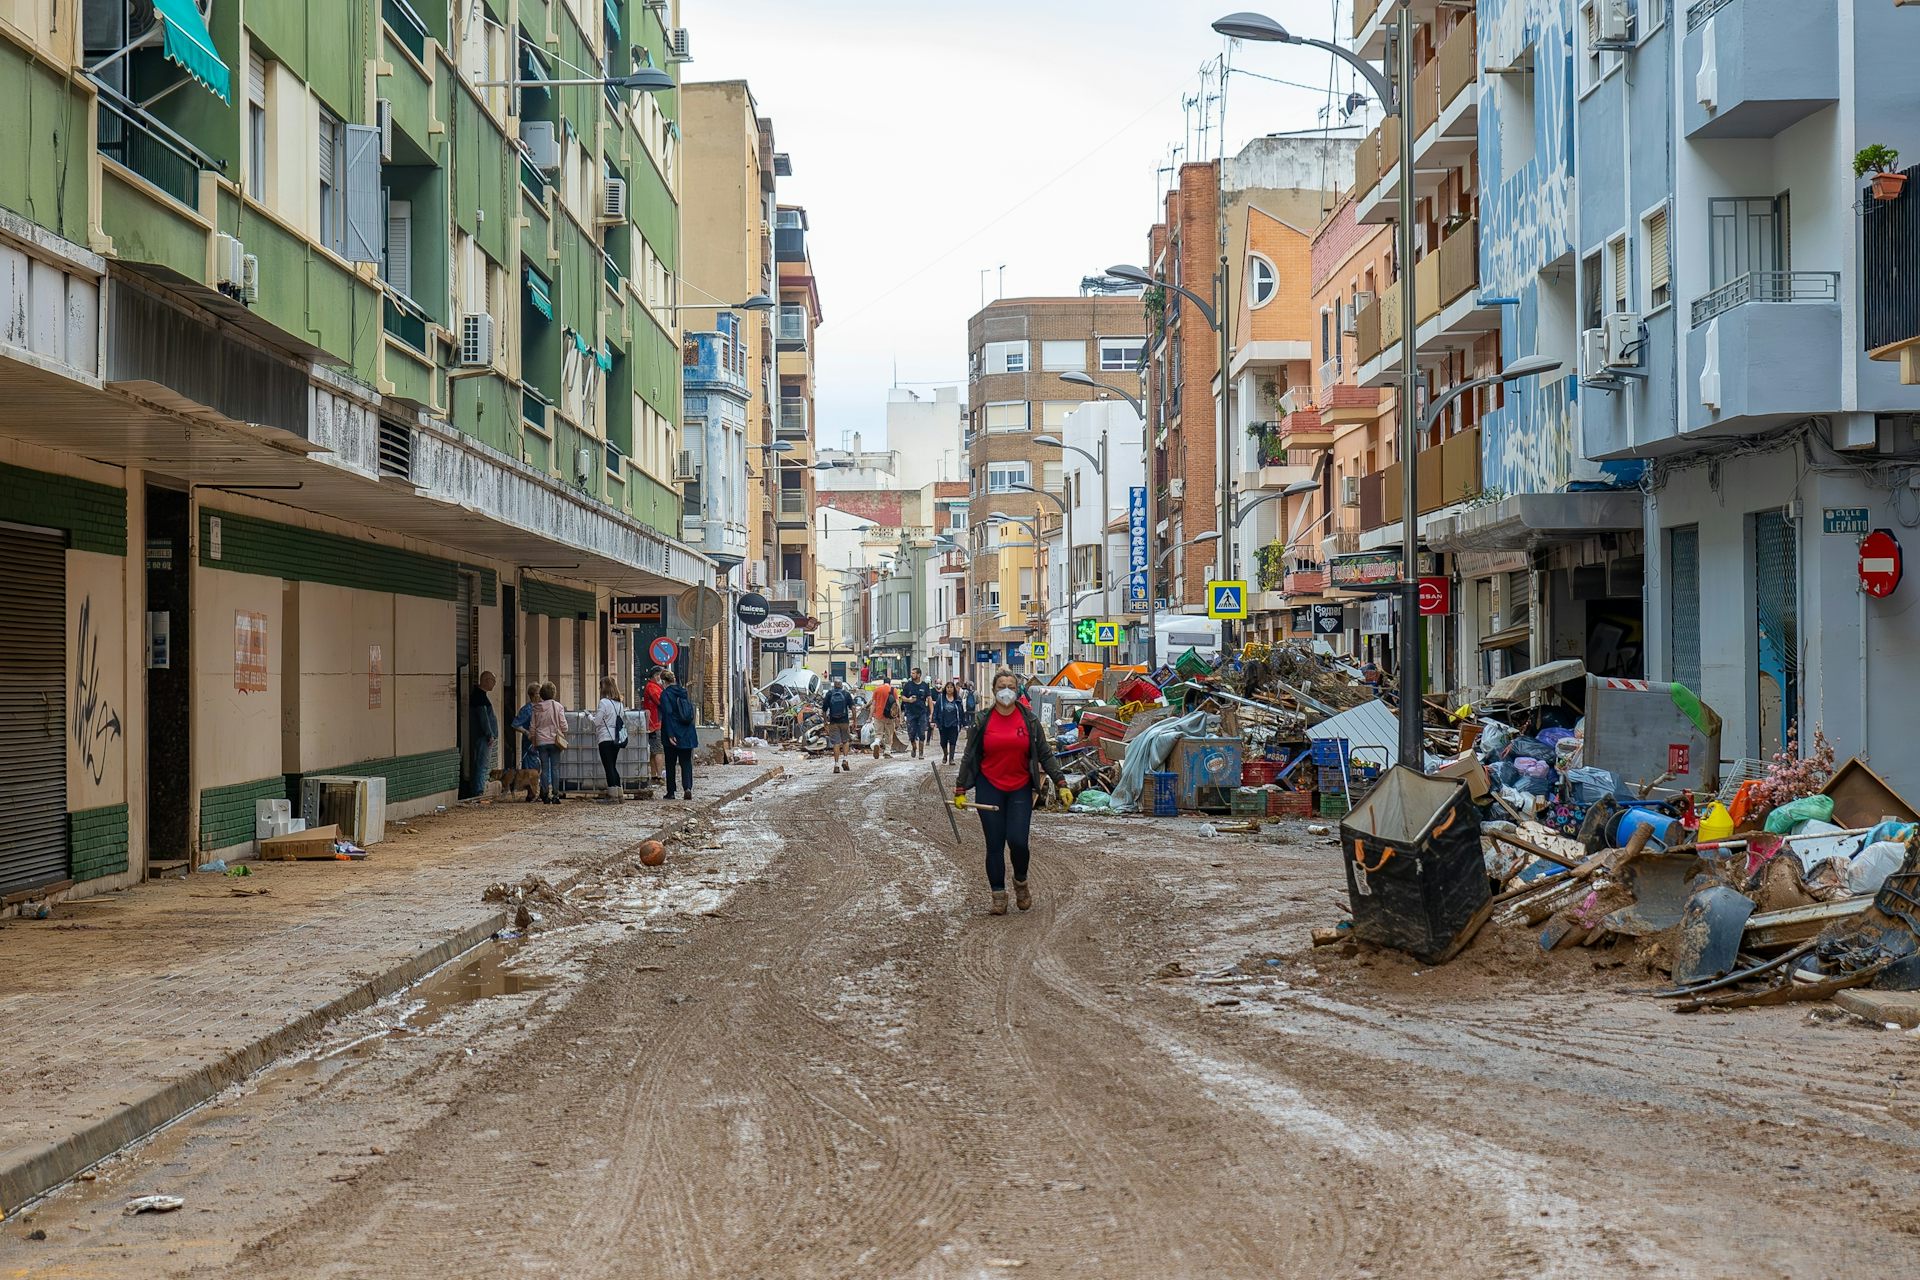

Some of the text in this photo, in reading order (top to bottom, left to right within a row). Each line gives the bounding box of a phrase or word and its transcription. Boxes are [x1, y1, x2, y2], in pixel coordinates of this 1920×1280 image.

[1830, 520, 1867, 531] LEPANTO
[1363, 561, 1396, 578] VERDURAS
[618, 603, 659, 614] KUUPS
[1131, 601, 1165, 610] HEROL
